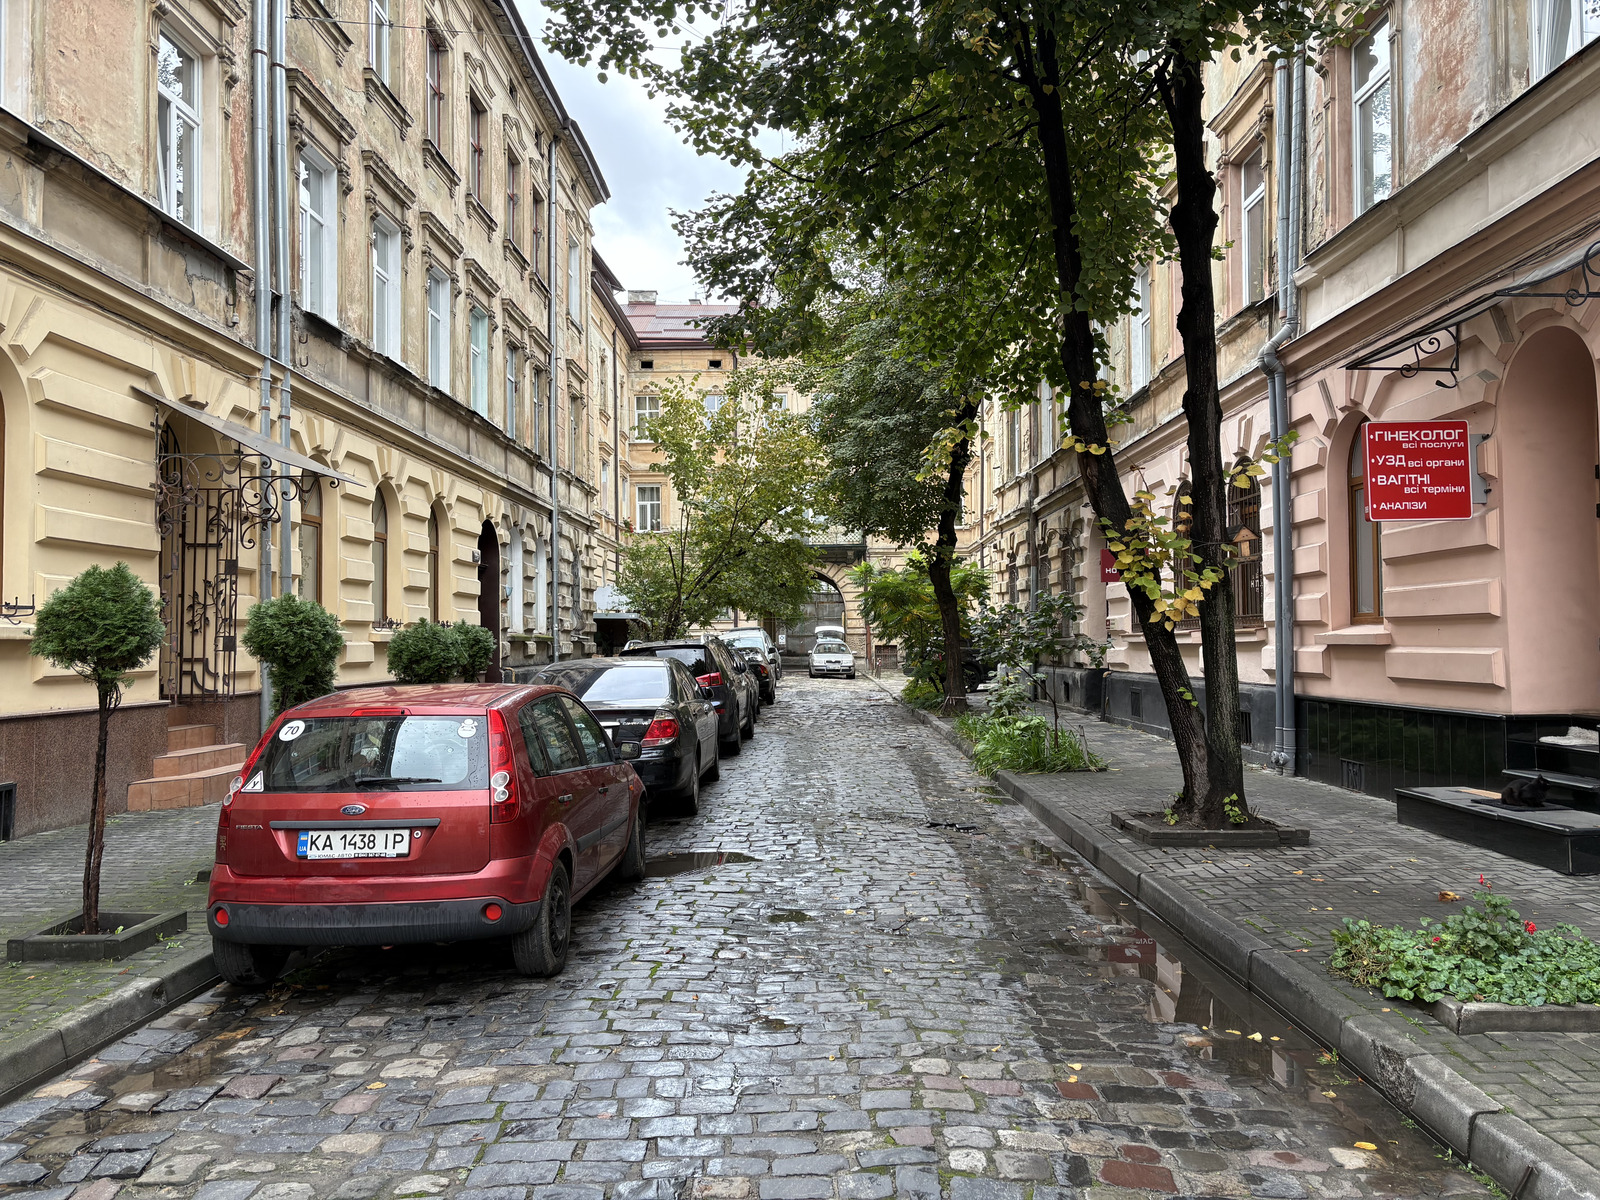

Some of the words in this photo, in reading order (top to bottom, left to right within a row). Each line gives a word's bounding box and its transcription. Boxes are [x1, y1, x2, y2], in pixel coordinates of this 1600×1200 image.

[1375, 430, 1464, 441] ГІНЕКОЛОГ
[1402, 441, 1418, 449] всі
[1420, 441, 1465, 449] послуги
[1376, 455, 1406, 467] УЗД
[1407, 458, 1424, 468] всі
[1426, 459, 1465, 469] органи
[1377, 474, 1430, 485] ВАГІТНІ
[1404, 484, 1420, 494] всі
[1422, 484, 1465, 495] терміни
[1379, 501, 1427, 510] АНАЛІЗИ
[284, 725, 300, 736] 70
[309, 834, 334, 851] KA
[339, 833, 377, 851] 1438
[384, 833, 405, 850] IP
